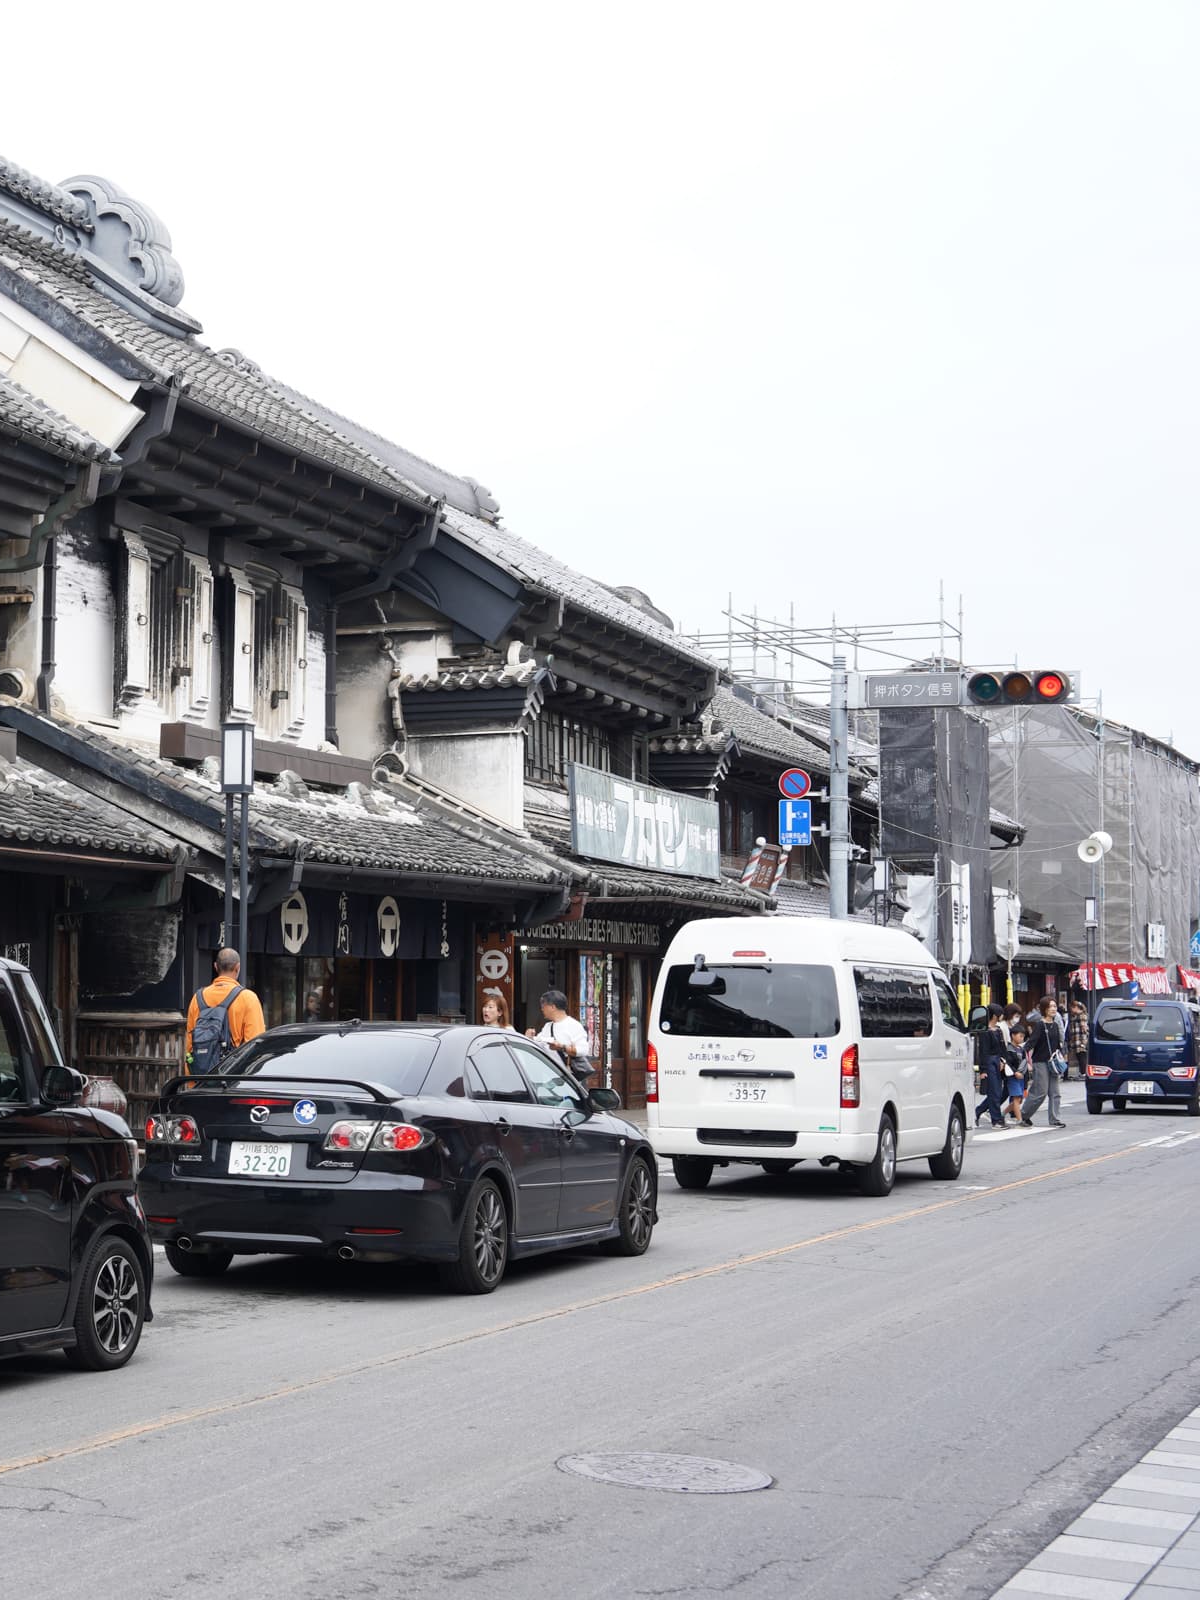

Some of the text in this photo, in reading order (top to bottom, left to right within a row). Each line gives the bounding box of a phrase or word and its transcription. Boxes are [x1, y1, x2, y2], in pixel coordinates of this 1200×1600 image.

[874, 682, 953, 698] 押ボタン信号
[735, 1088, 766, 1101] 39-57
[242, 1155, 287, 1173] 32-20
